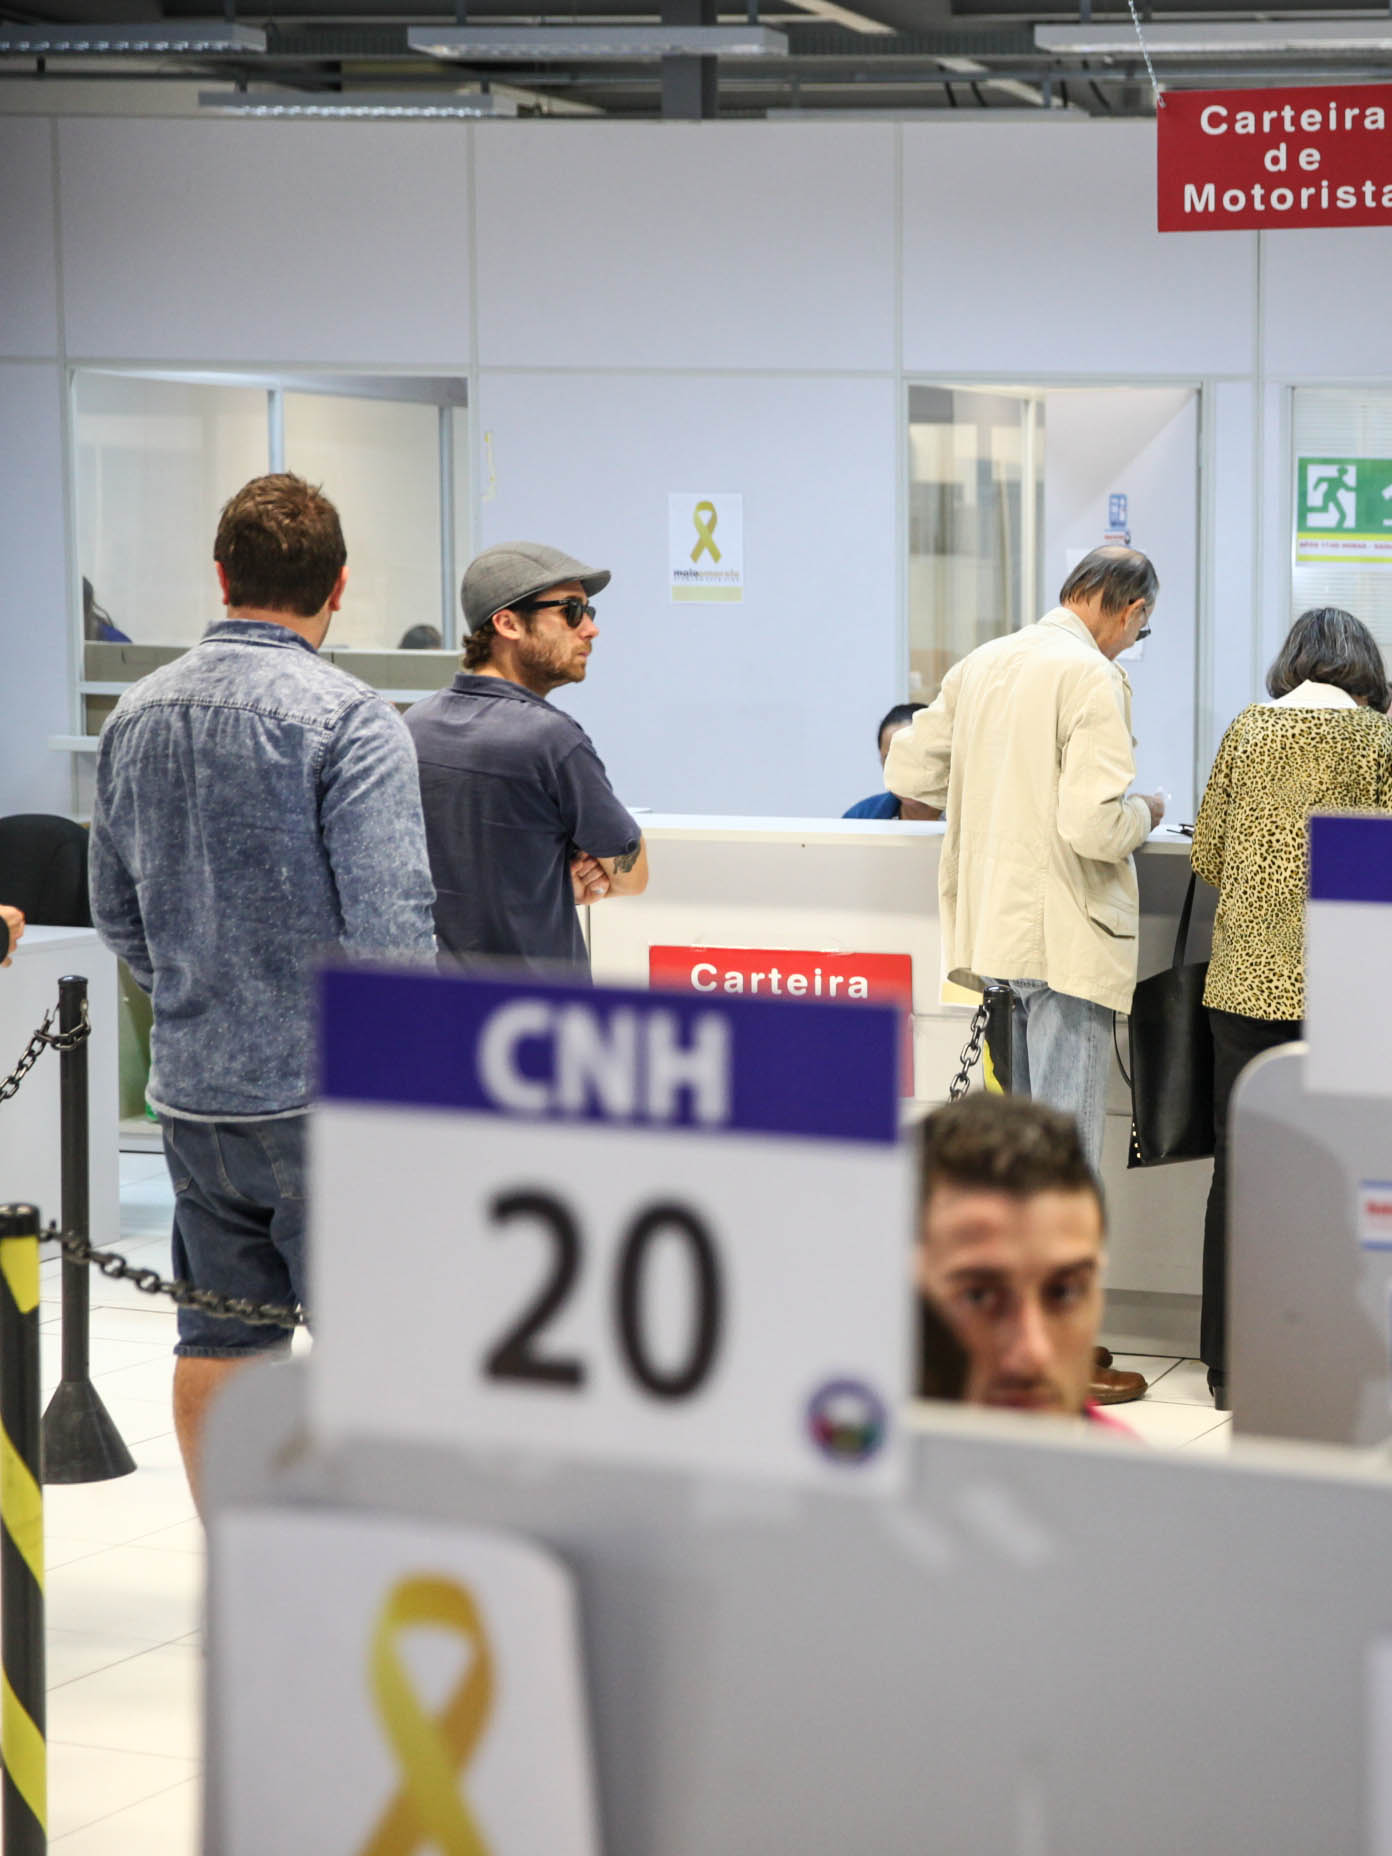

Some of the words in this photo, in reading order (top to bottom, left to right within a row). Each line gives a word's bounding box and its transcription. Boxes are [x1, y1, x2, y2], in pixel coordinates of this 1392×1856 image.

[1200, 102, 1386, 135] Carteira
[1264, 142, 1321, 172] de
[690, 963, 868, 999] Carteira
[476, 998, 733, 1127] CNH
[484, 1182, 726, 1405] 20
